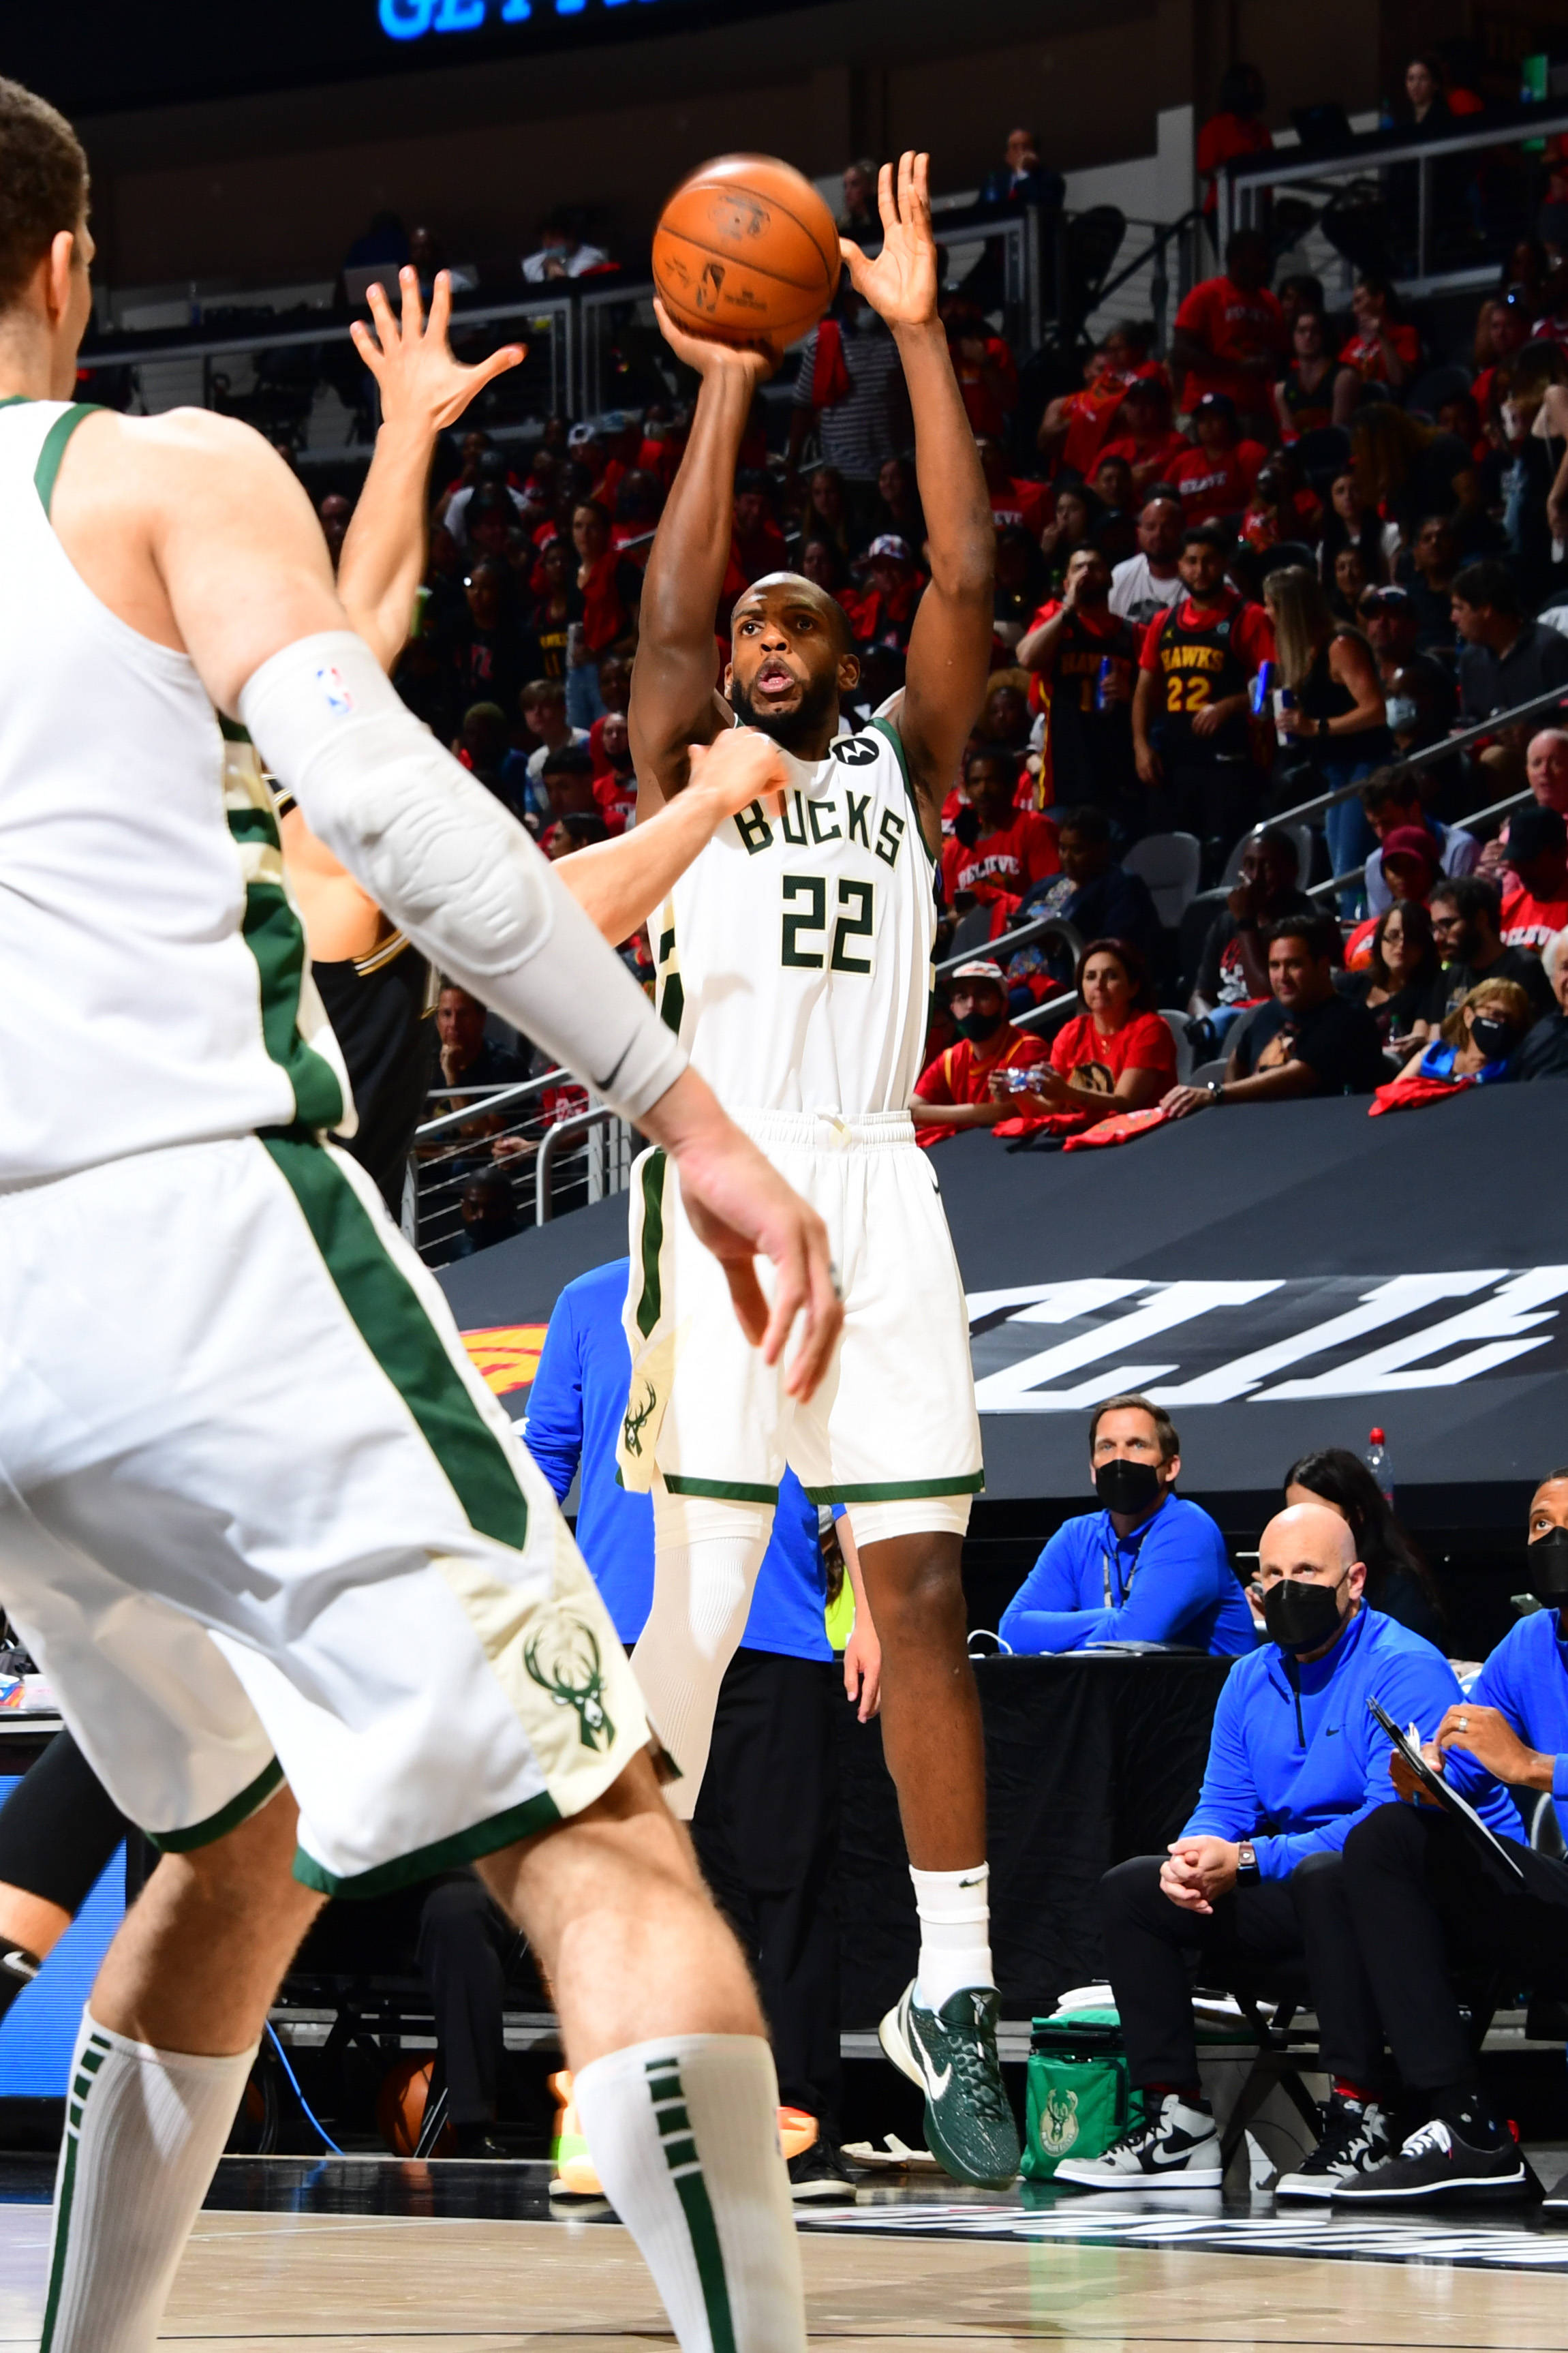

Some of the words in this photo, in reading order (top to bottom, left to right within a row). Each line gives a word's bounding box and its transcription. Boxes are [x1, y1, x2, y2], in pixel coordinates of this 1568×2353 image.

[1160, 645, 1224, 673] HAWKS
[1166, 675, 1211, 713] 22
[733, 789, 906, 872] BUCKS
[781, 873, 877, 977] 22
